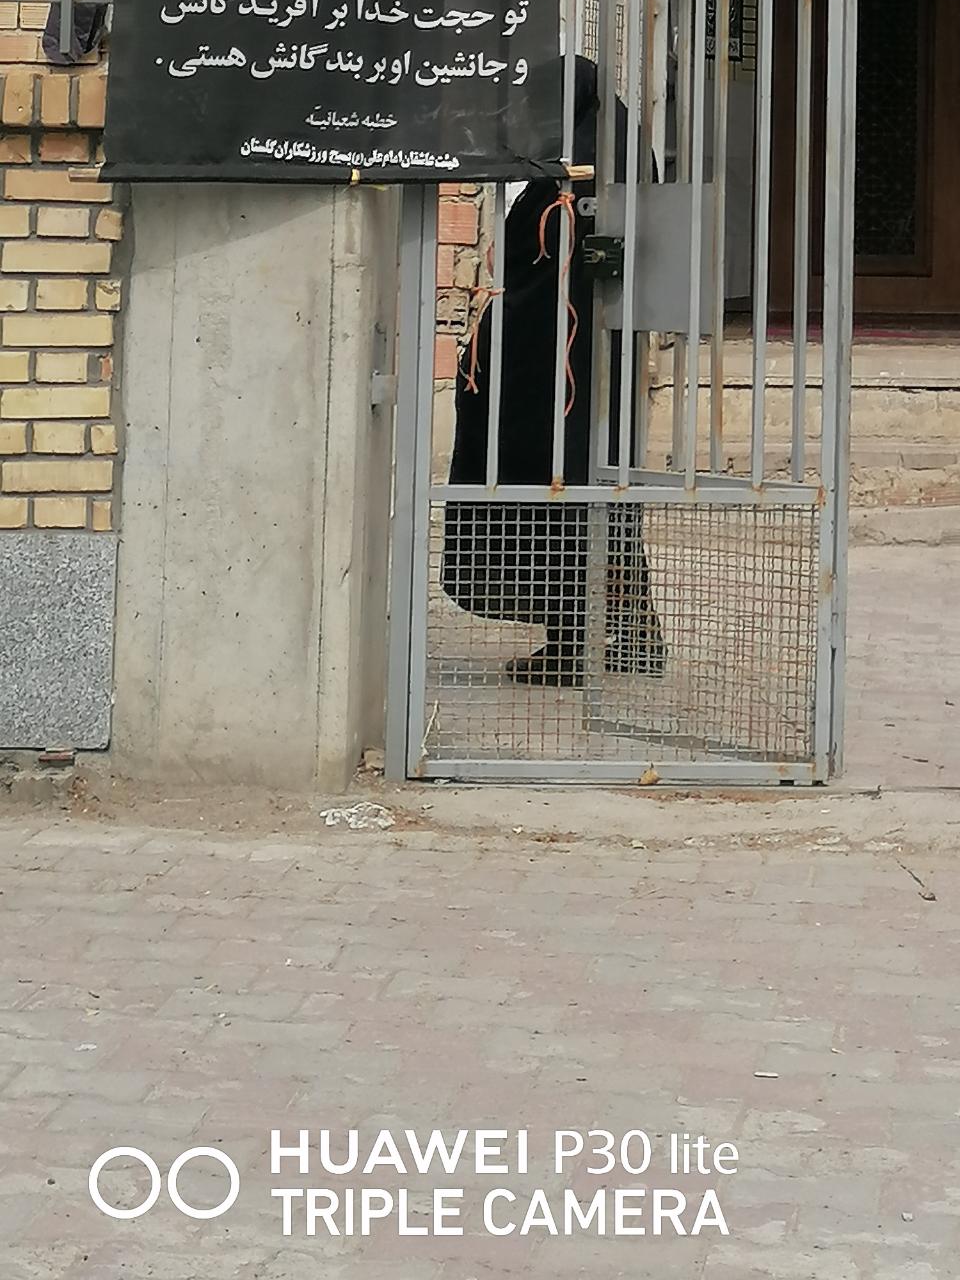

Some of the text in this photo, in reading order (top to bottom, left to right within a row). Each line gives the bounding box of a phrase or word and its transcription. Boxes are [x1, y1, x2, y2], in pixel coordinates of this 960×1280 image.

[324, 3, 348, 31] بر
[412, 3, 496, 35] حجت
[501, 0, 530, 37] تو
[414, 51, 510, 88] جانشین
[512, 59, 529, 86] و
[361, 112, 398, 132] خطبه
